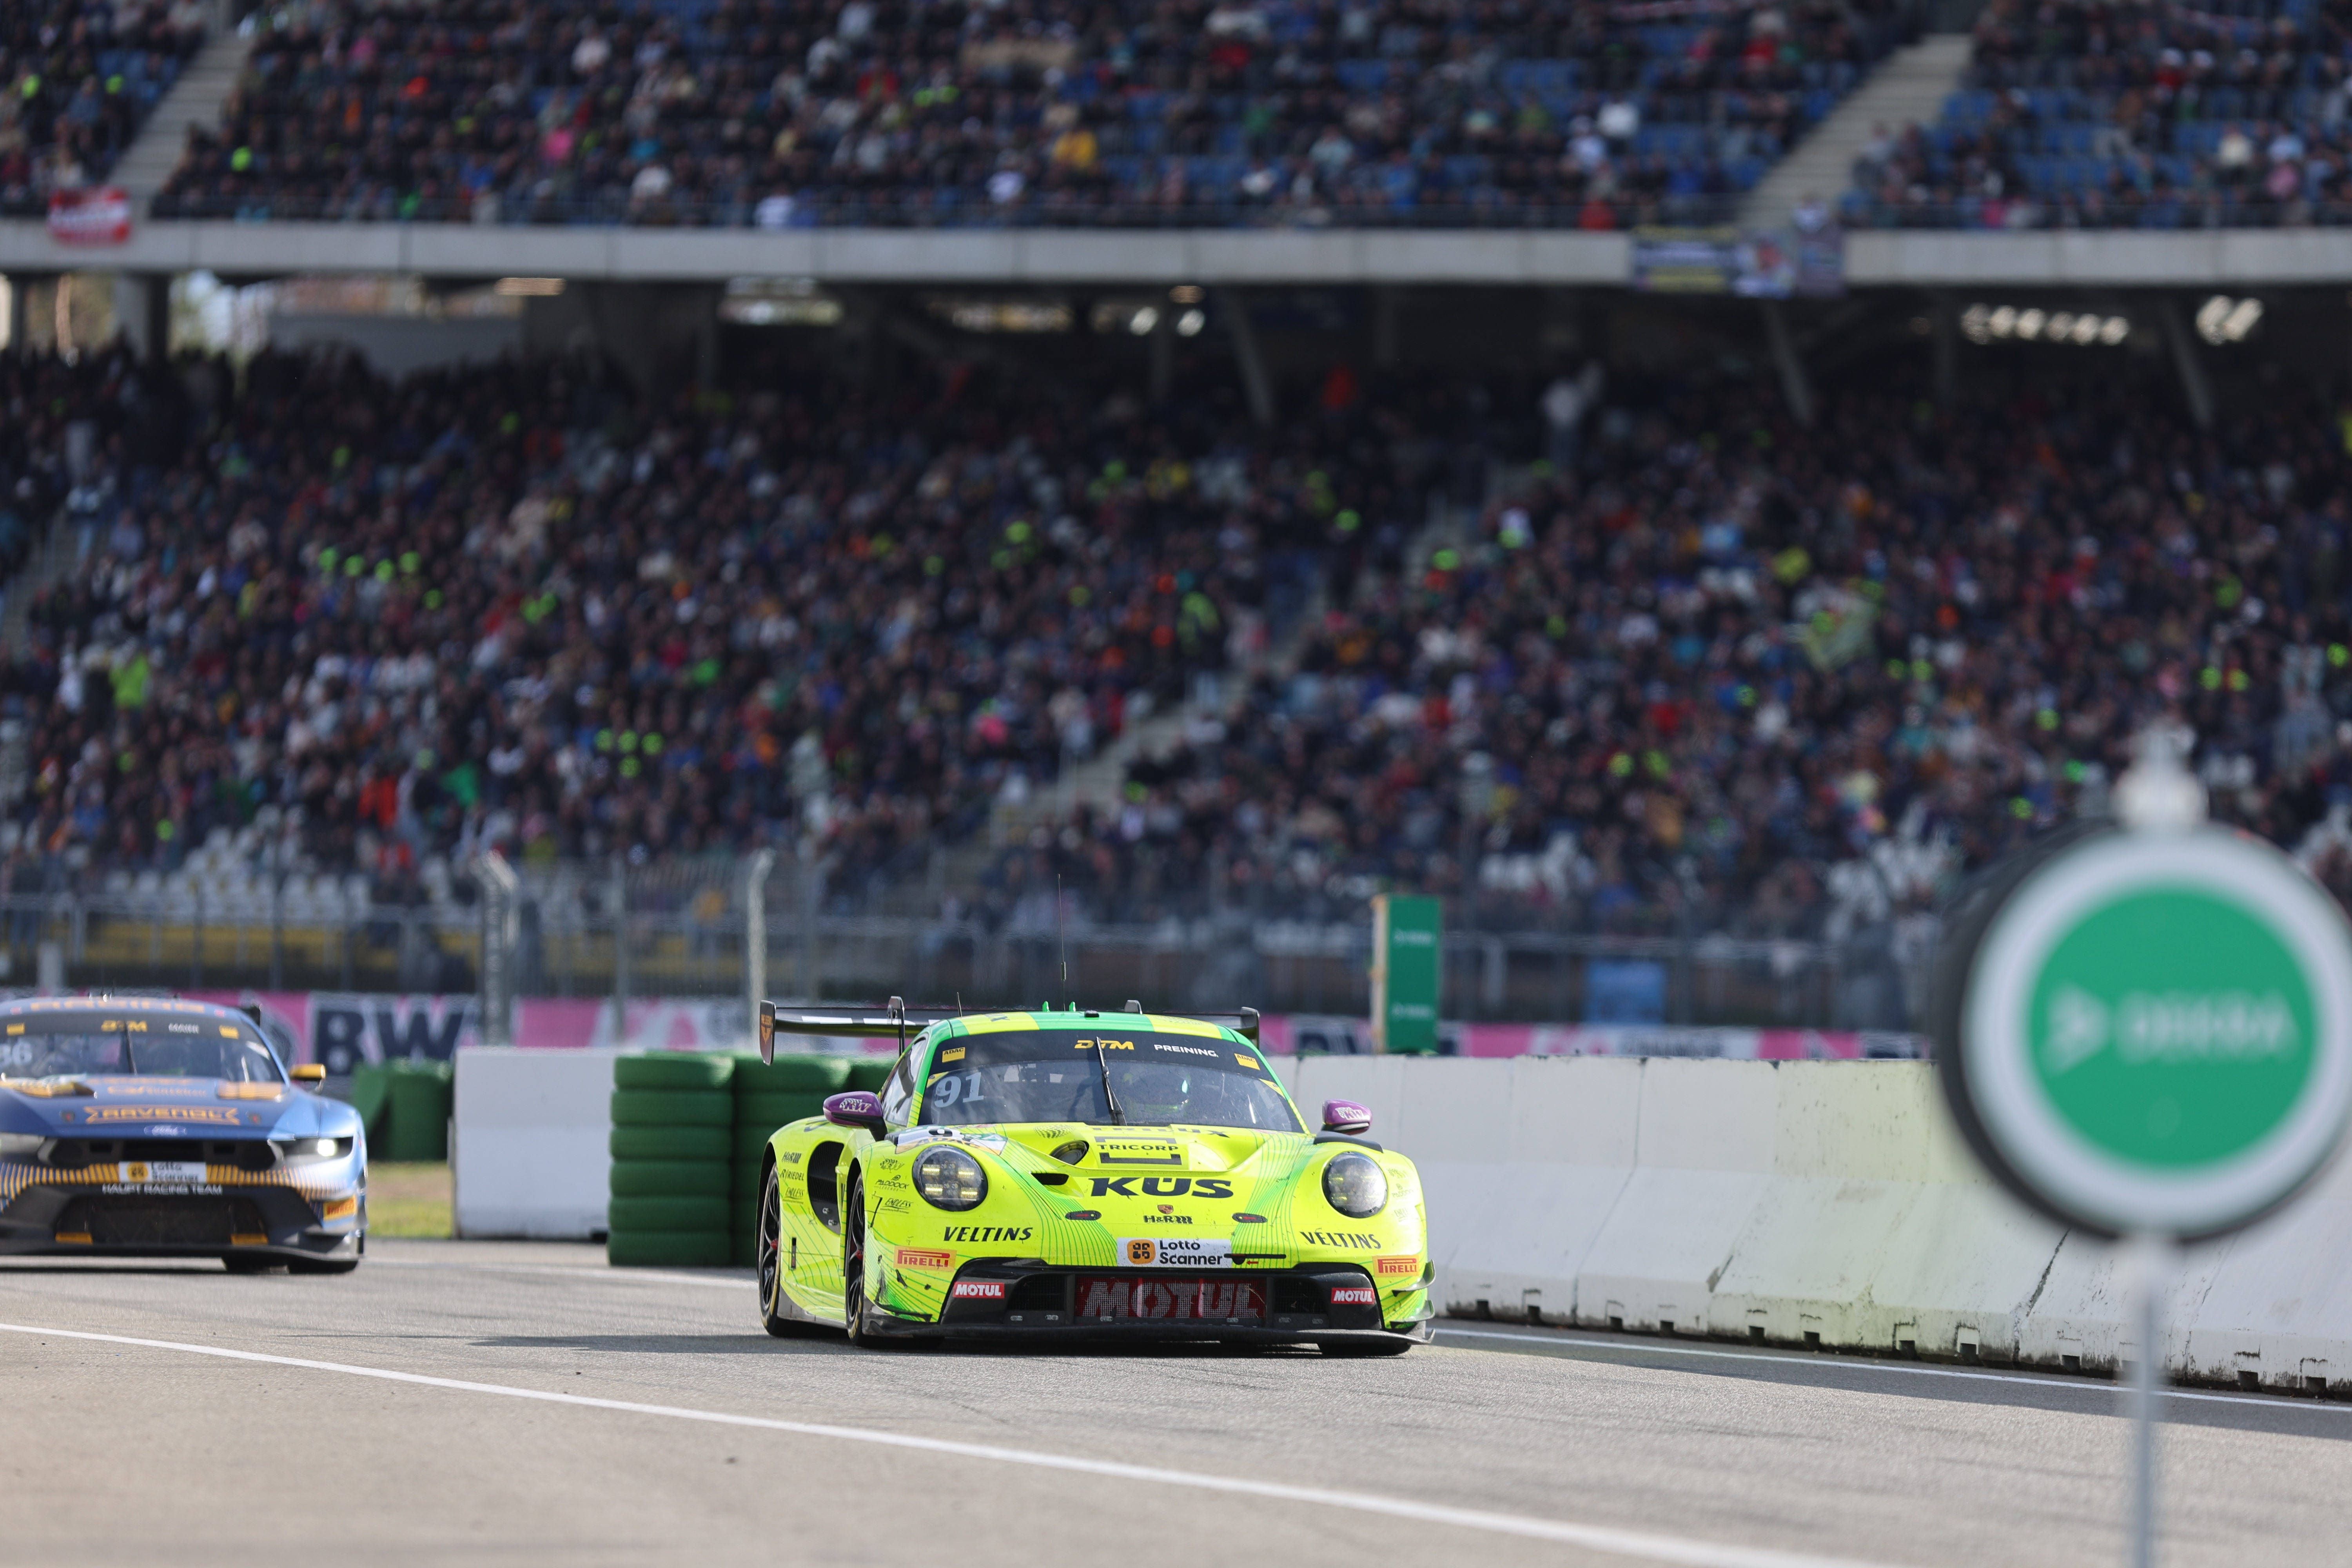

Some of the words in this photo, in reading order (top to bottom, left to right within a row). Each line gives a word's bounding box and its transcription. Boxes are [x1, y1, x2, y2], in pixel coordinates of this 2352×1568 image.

[315, 1010, 484, 1074] BW
[1074, 1040, 1134, 1051] DTM
[1237, 1054, 1256, 1063] ADAC
[935, 1072, 984, 1108] 91
[192, 1183, 223, 1195] TEAM
[875, 1180, 909, 1189] PADDOCK
[1089, 1177, 1234, 1198] KÜS
[885, 1198, 913, 1207] ENDLESS
[943, 1227, 1033, 1242] VELTINS
[1299, 1231, 1382, 1249] VELTINS
[1159, 1240, 1200, 1250] Lotto
[897, 1249, 950, 1267] PIRELLI
[1159, 1252, 1222, 1265] Scanner
[1377, 1258, 1417, 1274] PIRELLI
[955, 1284, 1002, 1297] MOTUL
[1334, 1290, 1374, 1302] MOTUL
[1082, 1281, 1259, 1318] MOTUL
